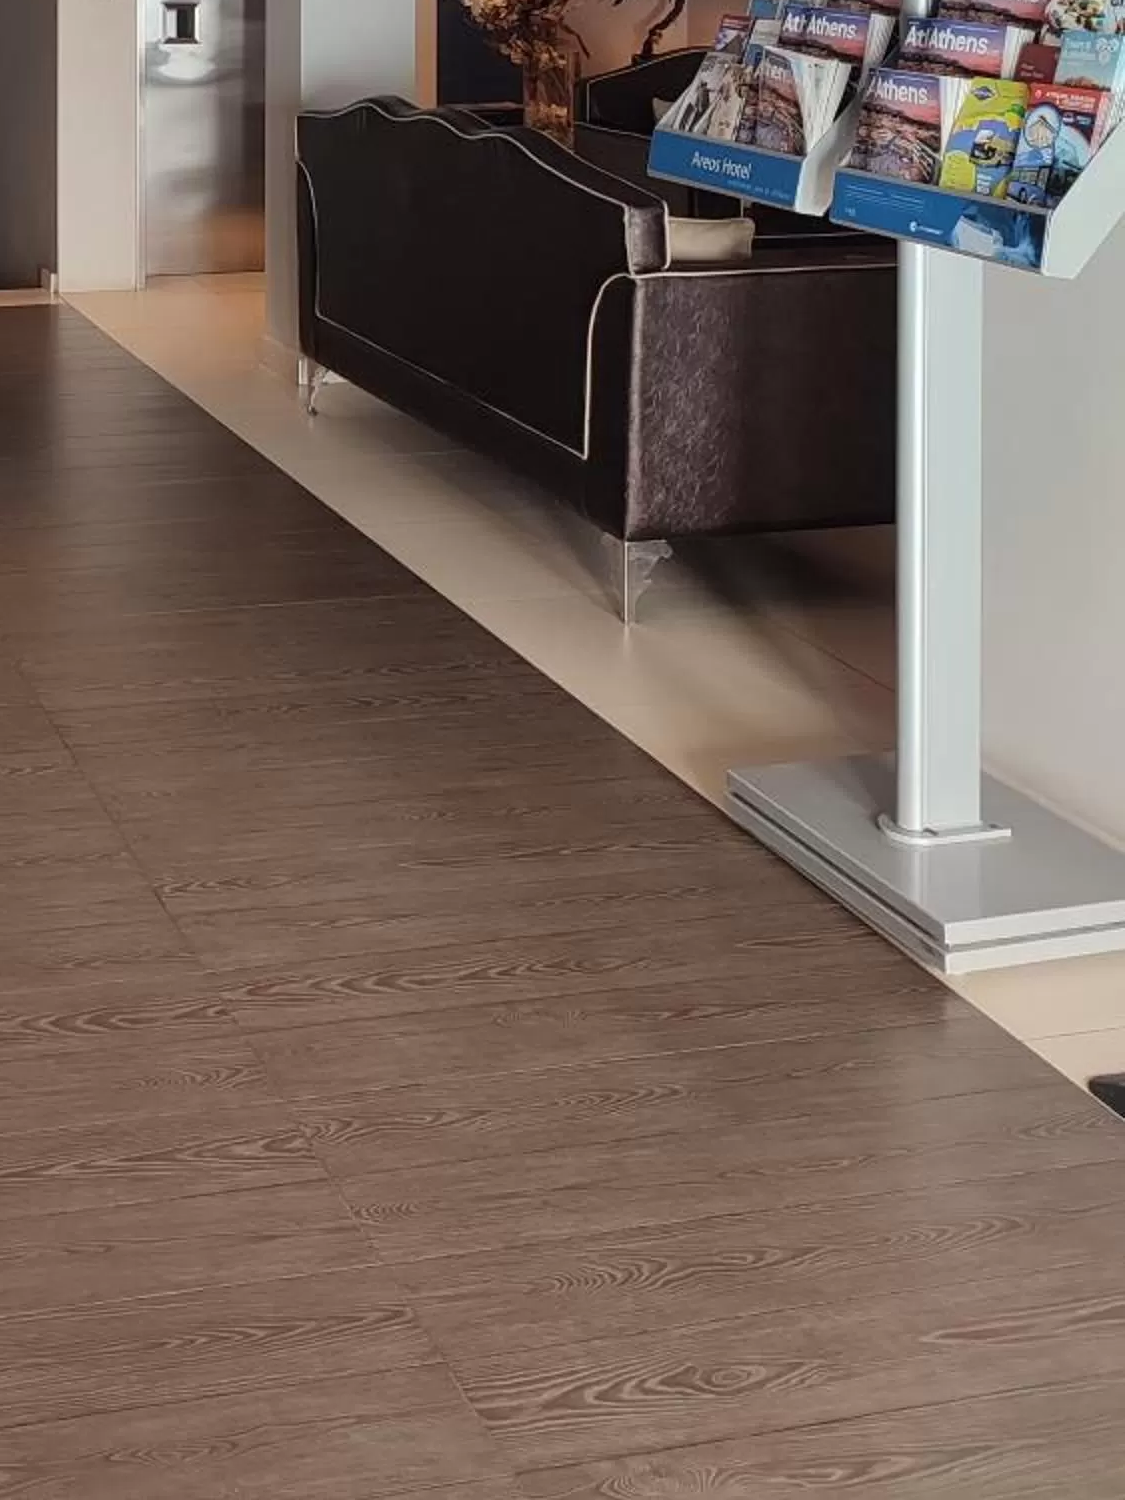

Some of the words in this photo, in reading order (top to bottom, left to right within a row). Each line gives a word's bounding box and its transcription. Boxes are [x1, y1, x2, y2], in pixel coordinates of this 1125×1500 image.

[807, 15, 857, 40] Athens
[928, 25, 988, 54] Athens
[875, 74, 929, 105] Athens
[692, 152, 720, 172] Areos
[723, 158, 752, 179] Hotel
